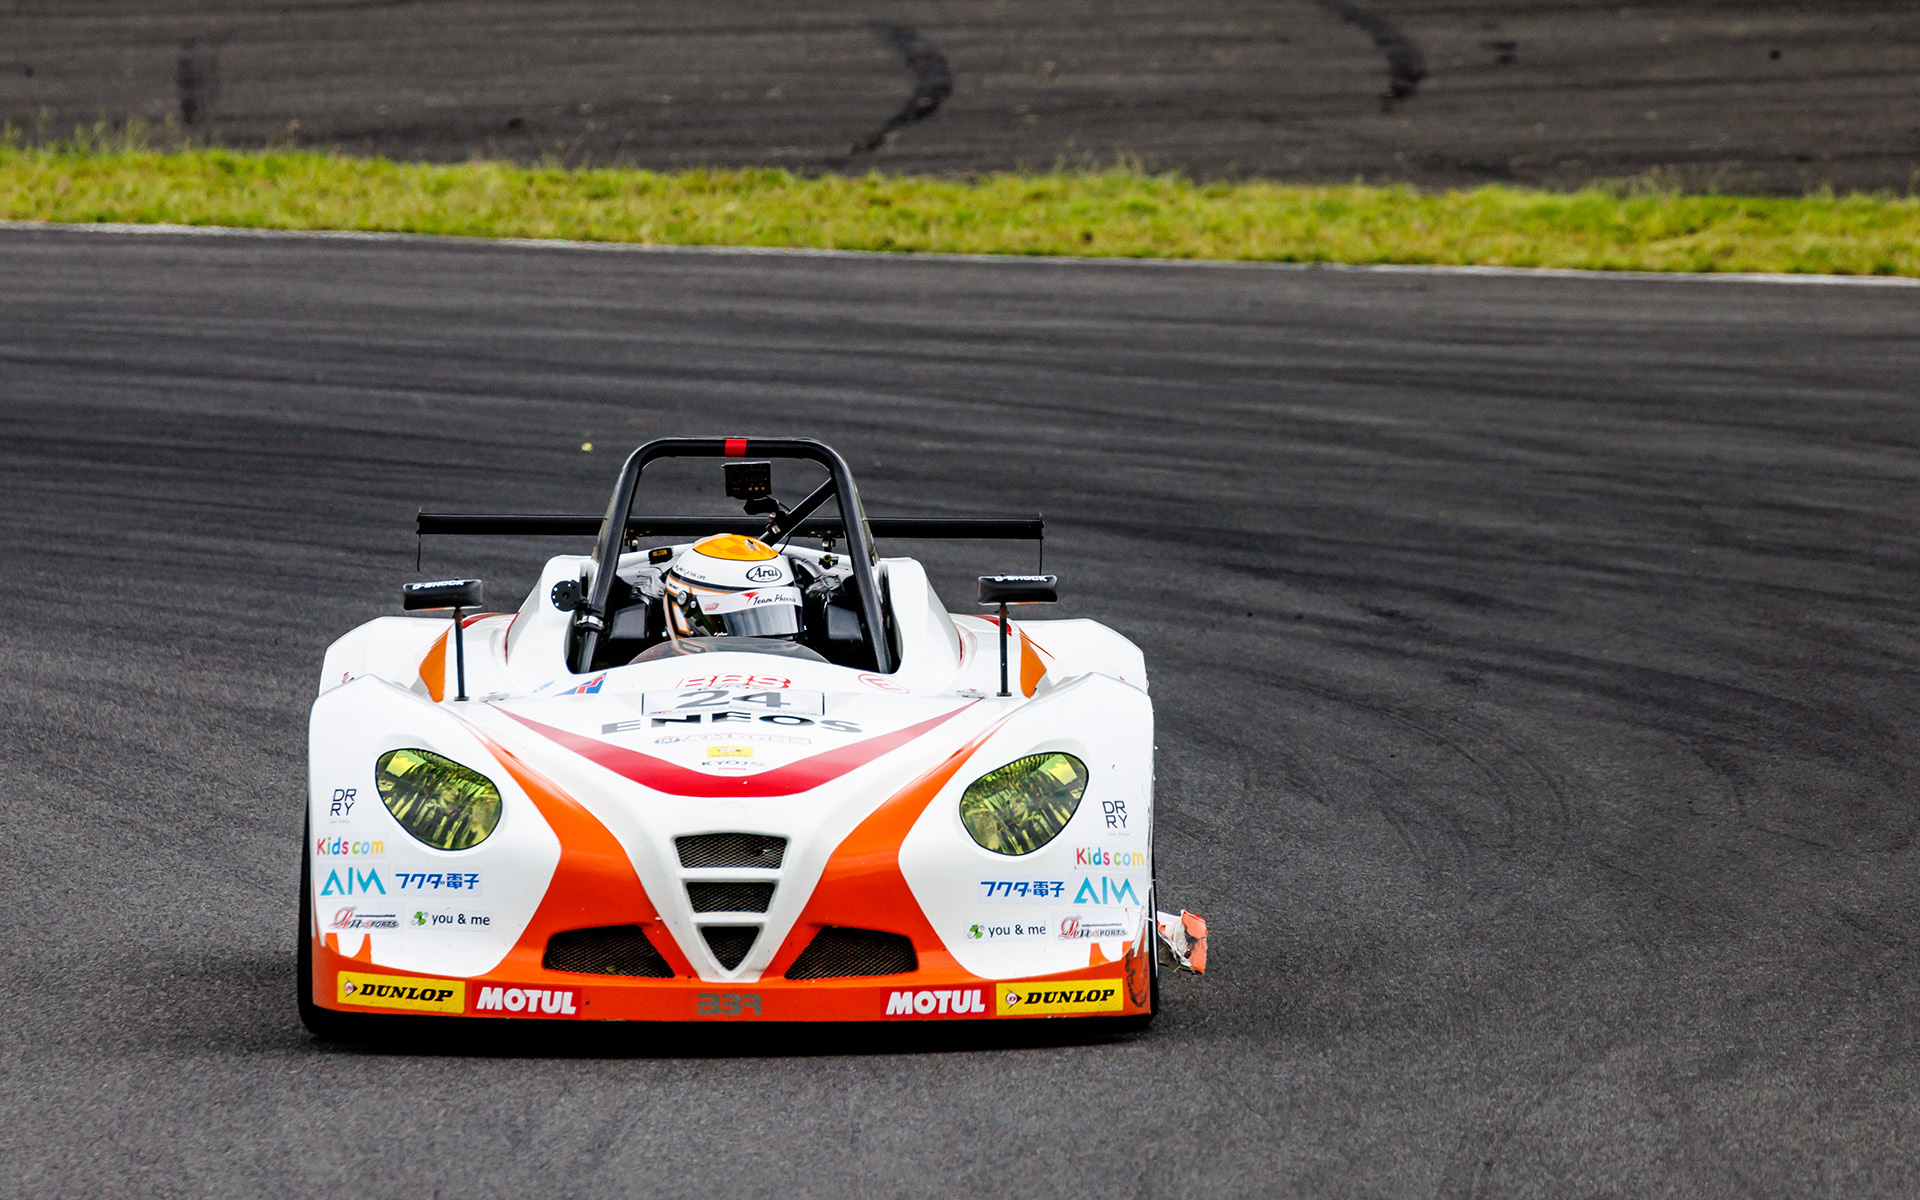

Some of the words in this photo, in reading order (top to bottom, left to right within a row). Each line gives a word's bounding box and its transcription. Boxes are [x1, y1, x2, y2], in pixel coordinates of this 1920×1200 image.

[750, 567, 778, 580] Arai
[412, 579, 466, 590] G-SHOCK
[753, 596, 773, 606] Team
[675, 690, 791, 709] 24
[601, 711, 863, 735] ENEOS
[333, 788, 357, 802] DR
[330, 802, 355, 817] RY
[1102, 800, 1127, 814] DR
[1106, 814, 1128, 829] RY
[316, 837, 349, 856] Kids
[352, 841, 384, 855] com
[1076, 847, 1111, 866] Kids
[1113, 852, 1145, 866] com
[320, 867, 386, 896] AIM
[395, 873, 480, 890] フクダ電子
[980, 881, 1065, 898] フクダ電子
[1073, 876, 1141, 905] AIM
[431, 914, 453, 925] you
[457, 914, 467, 925] &
[470, 915, 490, 926] me
[988, 926, 1011, 938] you
[1014, 924, 1024, 935] &
[1028, 924, 1047, 935] me
[359, 983, 454, 1002] DUNLOP
[476, 986, 577, 1015] MOTUL
[1024, 988, 1115, 1005] DUNLOP
[886, 989, 985, 1015] MOTUL
